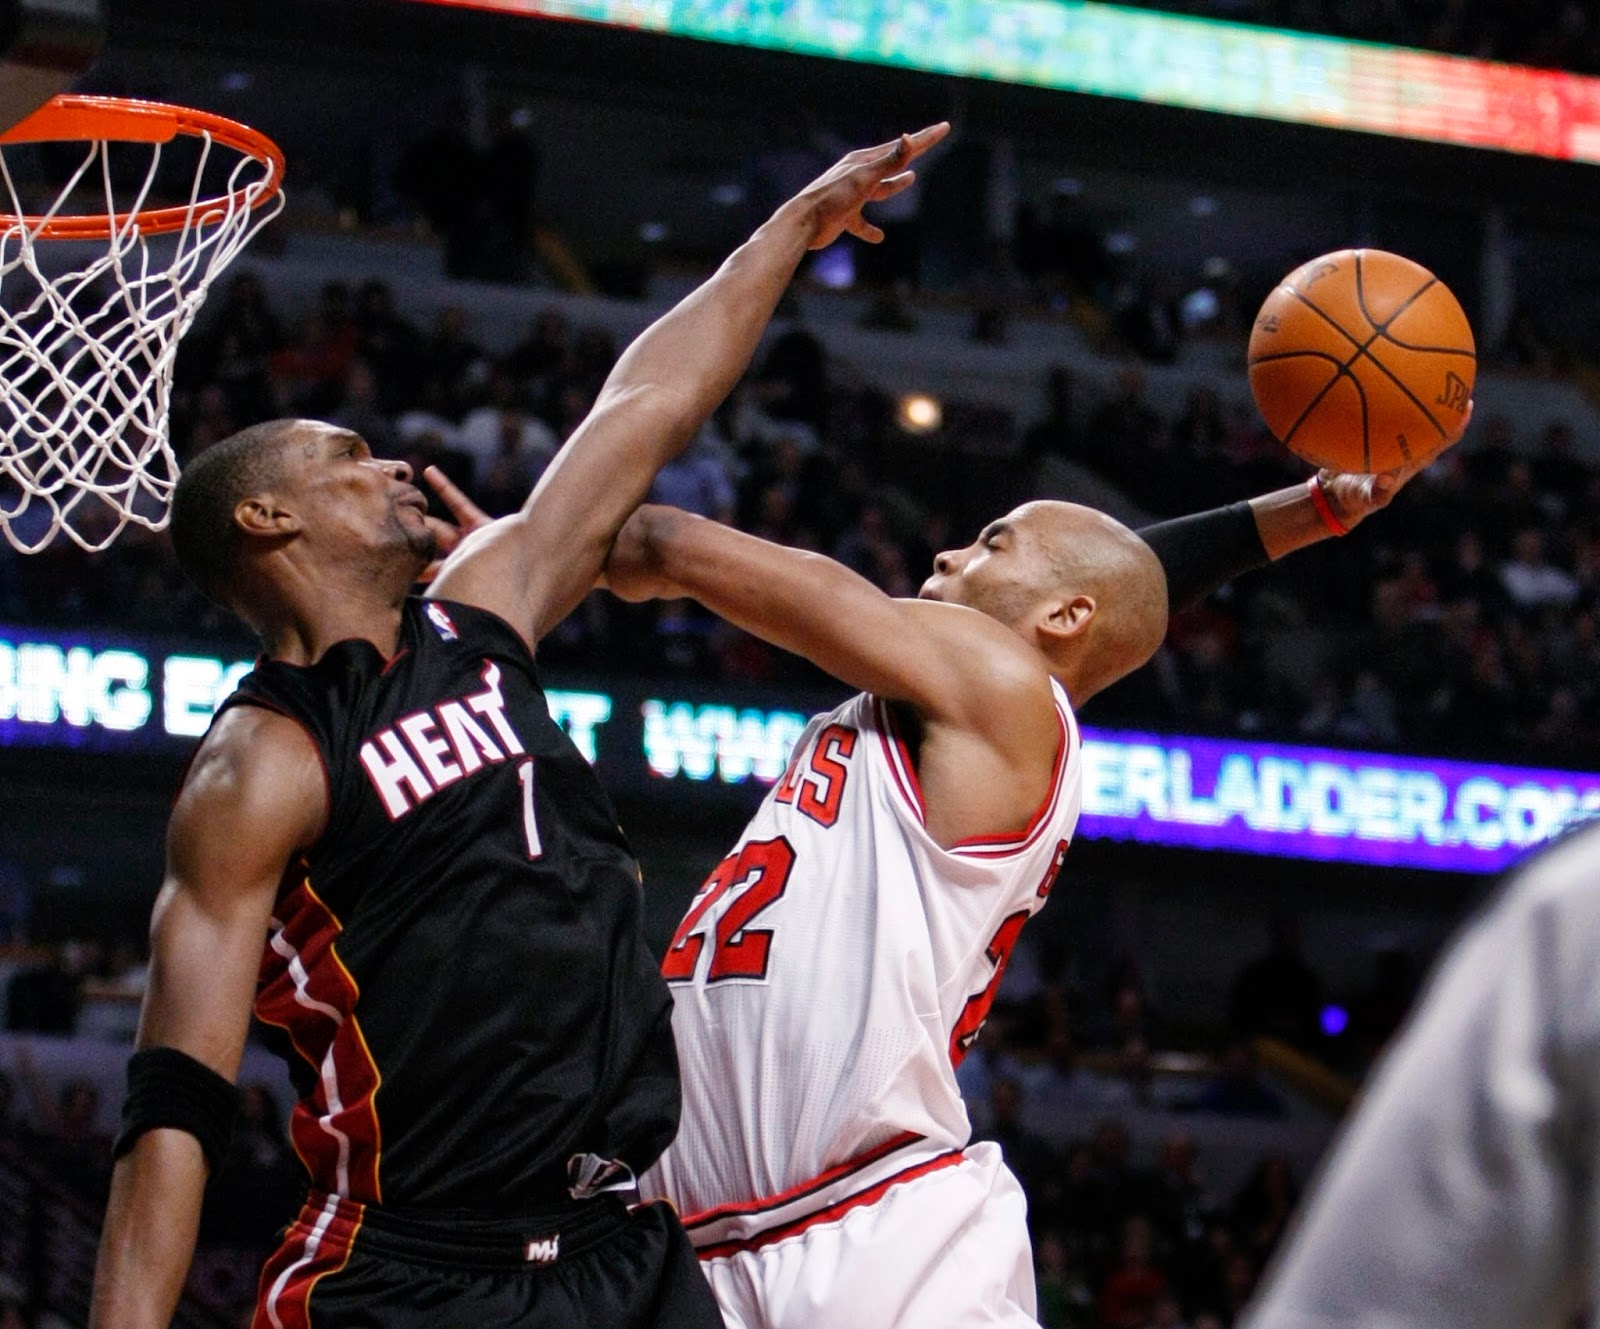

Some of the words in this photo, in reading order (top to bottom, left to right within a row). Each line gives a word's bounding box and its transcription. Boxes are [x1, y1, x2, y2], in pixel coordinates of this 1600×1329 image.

[358, 658, 526, 823] HEAT
[515, 756, 543, 862] 1
[660, 834, 797, 984] 22
